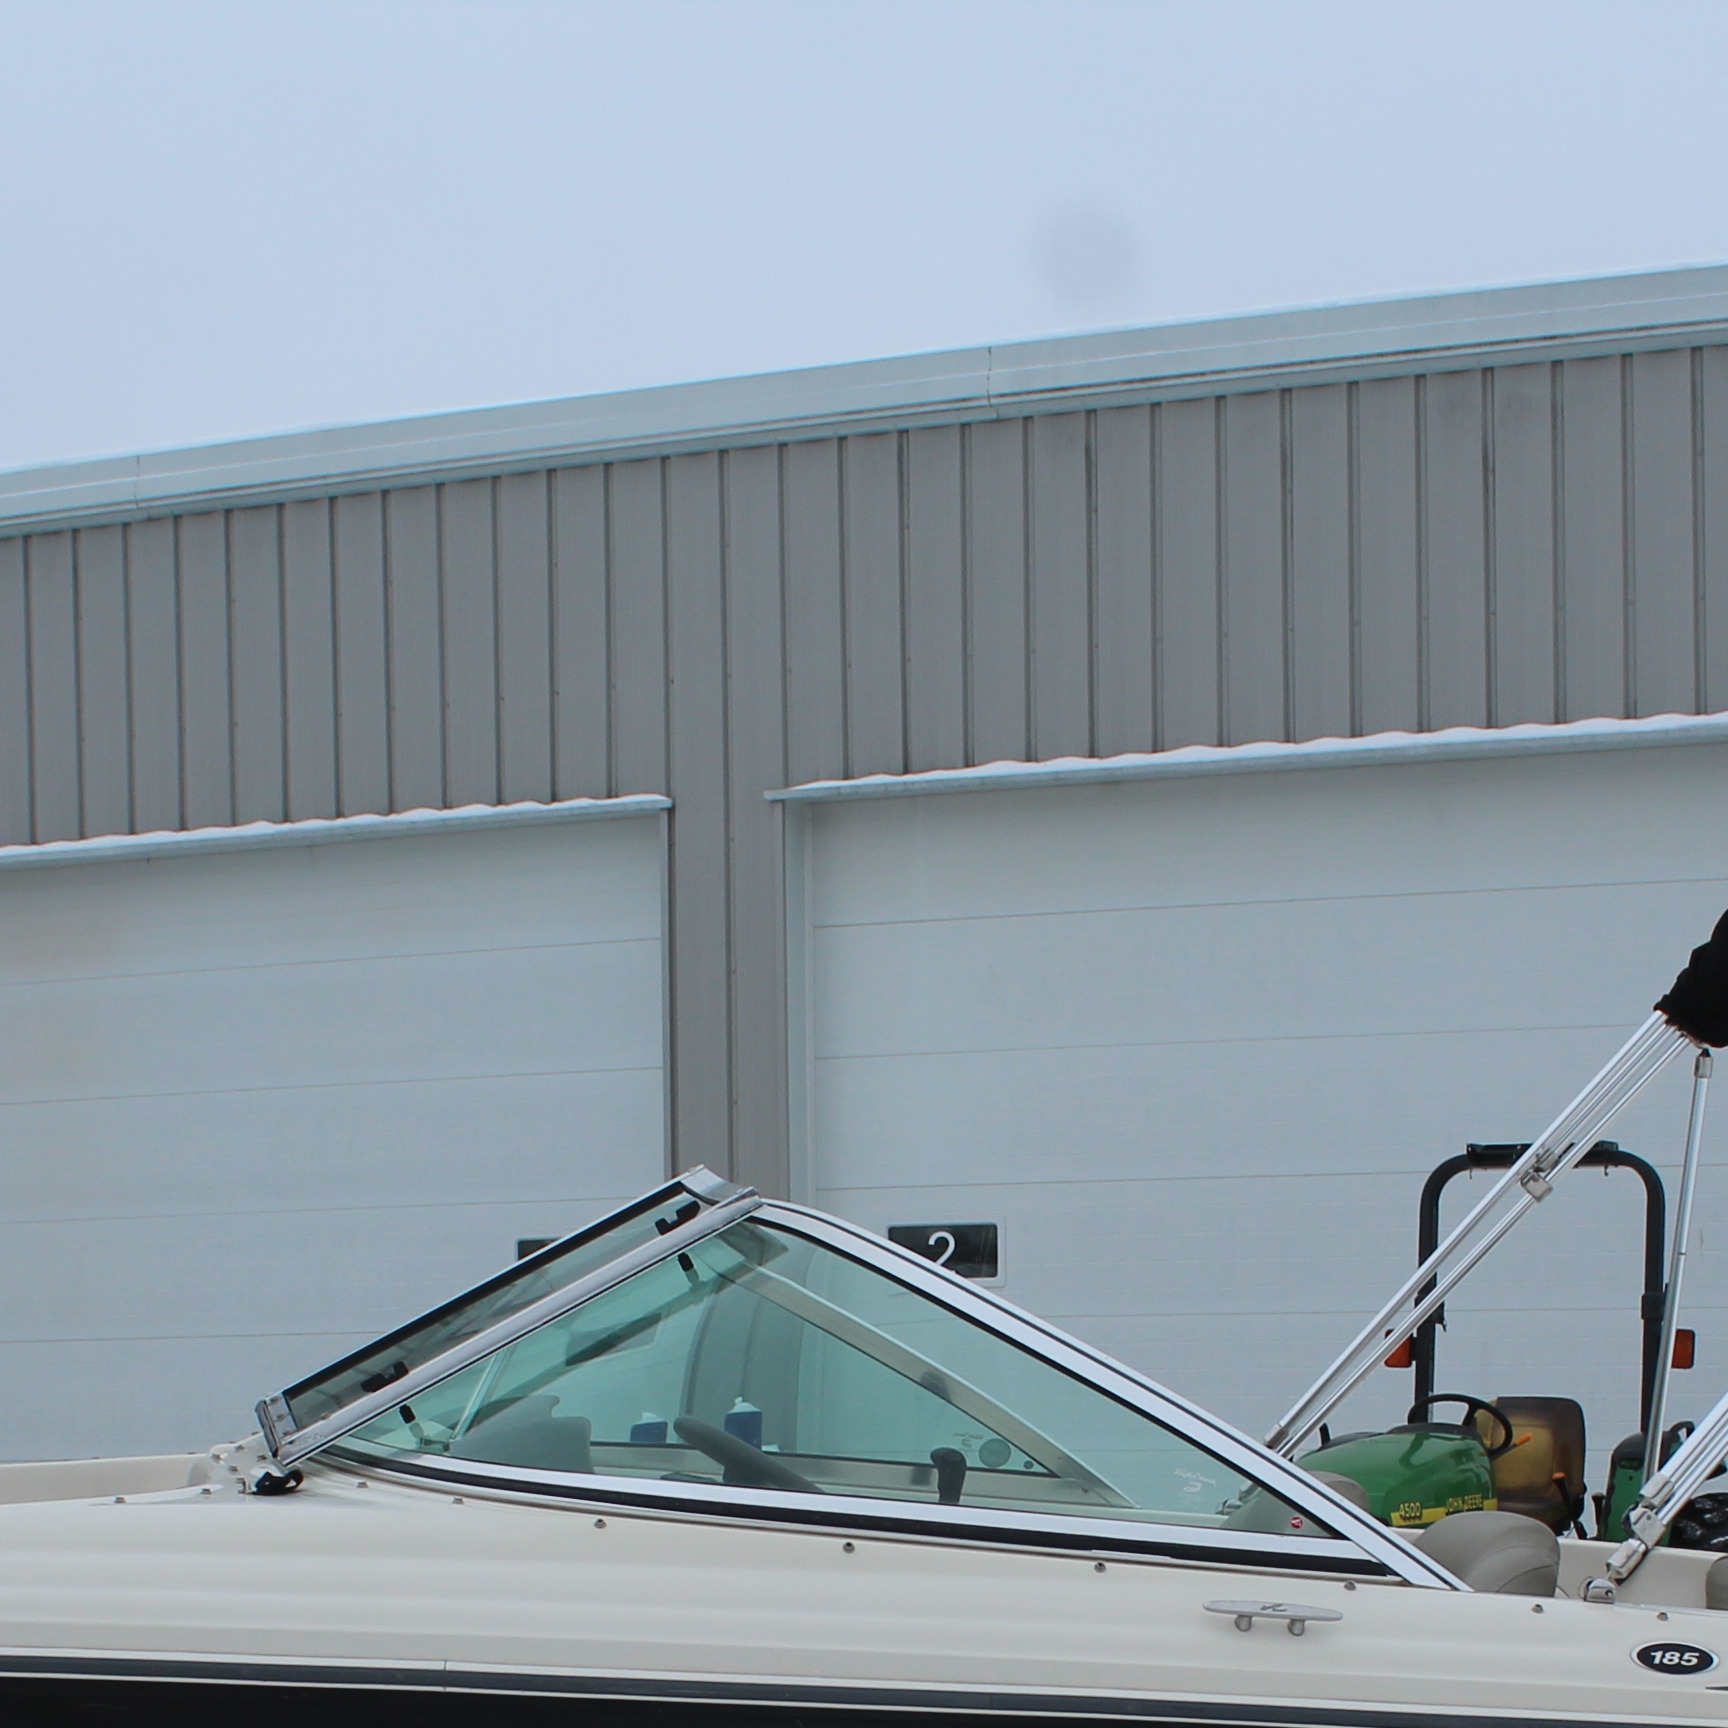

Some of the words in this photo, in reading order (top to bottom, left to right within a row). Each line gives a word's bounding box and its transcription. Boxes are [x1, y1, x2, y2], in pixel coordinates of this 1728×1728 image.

[928, 1231, 957, 1274] 2
[1398, 1502, 1421, 1518] 4500
[1650, 1651, 1700, 1666] 185
